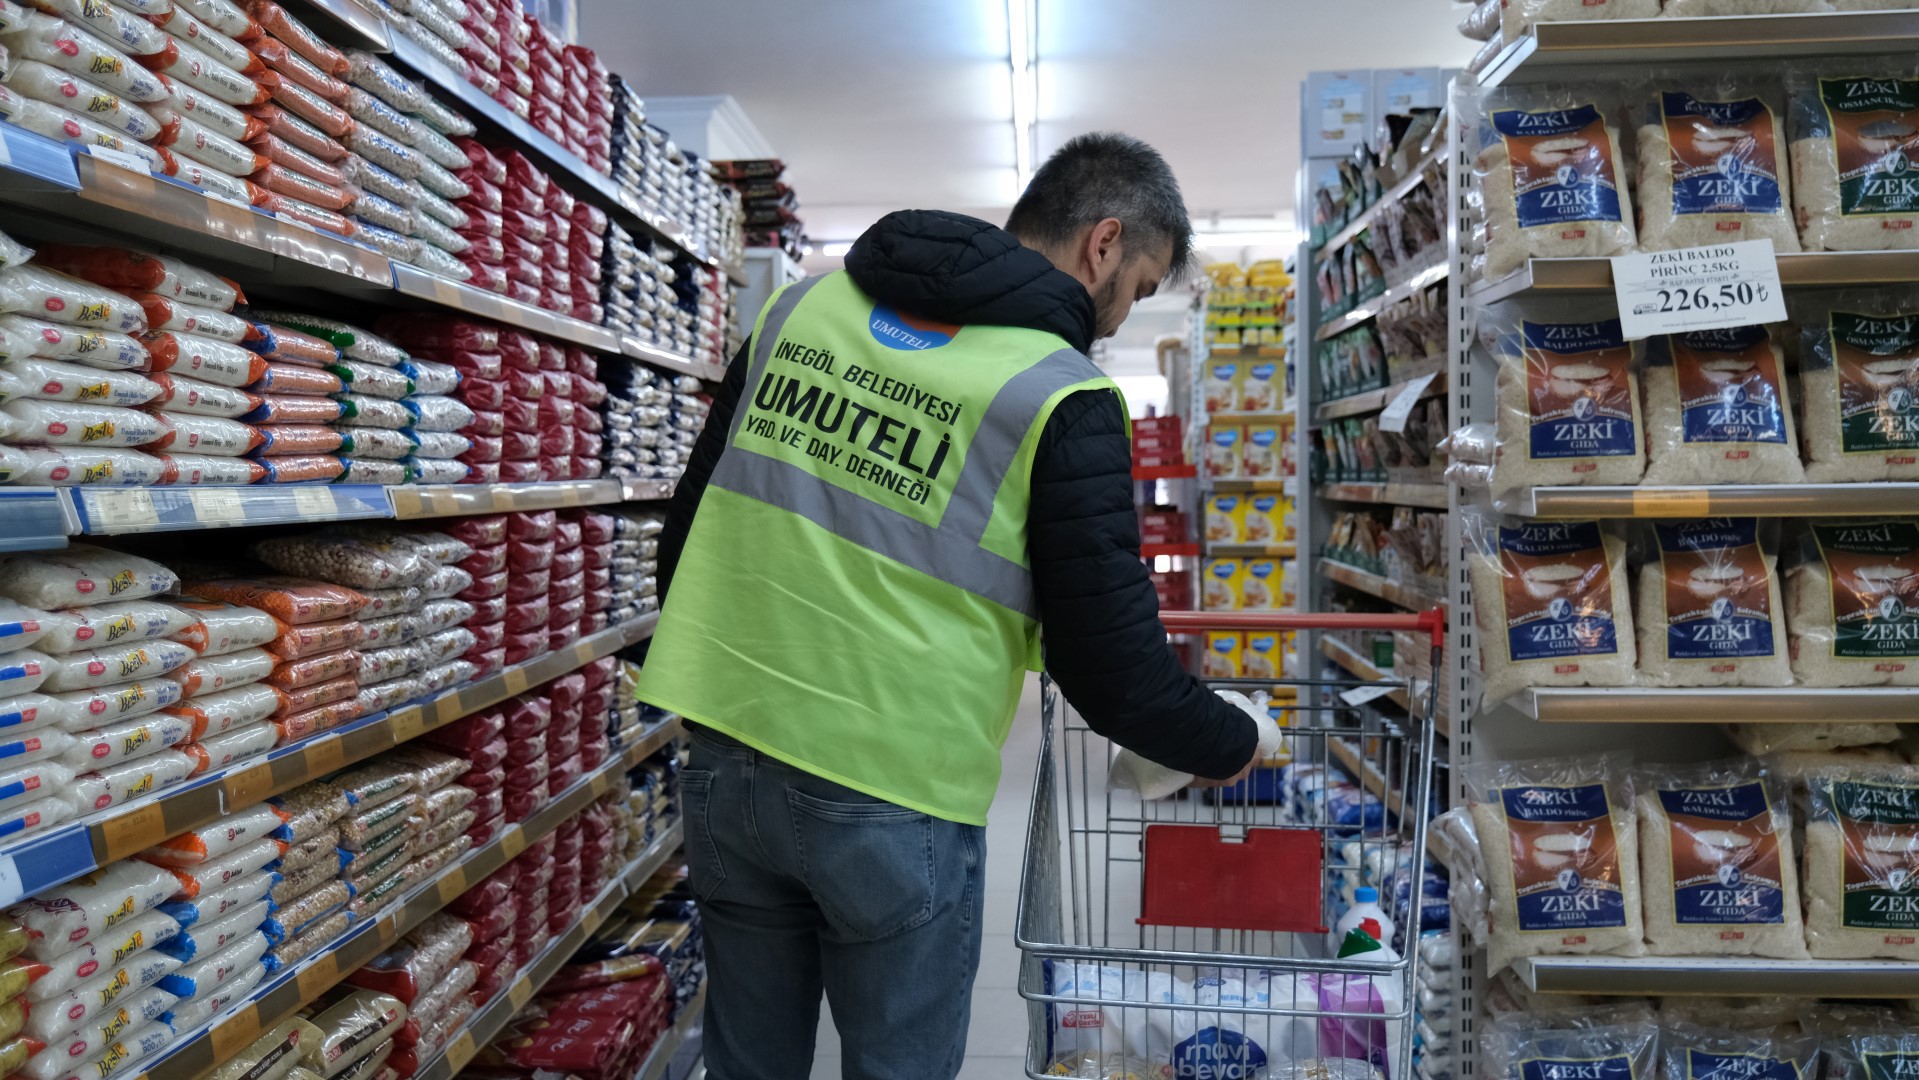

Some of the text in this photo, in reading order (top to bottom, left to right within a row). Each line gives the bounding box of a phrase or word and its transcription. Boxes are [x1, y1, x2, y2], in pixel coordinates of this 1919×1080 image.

[90, 56, 122, 73] Besle
[1846, 79, 1900, 97] ZEKİ
[1517, 110, 1570, 128] ZEKİ
[1698, 177, 1759, 196] ZEKİ
[1867, 178, 1919, 196] ZEK
[1650, 247, 1735, 265] ZEKİ BALDO
[1650, 260, 1739, 278] PİRİNÇ 2,5KG
[872, 318, 932, 350] UMUTELİ
[1544, 323, 1600, 339] ZEKİ
[1543, 340, 1583, 349] BALDO
[774, 338, 963, 426] İNEGÖL BELEDİYESİ
[1531, 408, 1571, 423] Topraktan
[1707, 406, 1765, 425] ZEKİ
[1869, 415, 1919, 433] ZEK
[754, 372, 951, 481] UMUTELİ
[1554, 418, 1614, 441] ZEKİ
[1570, 440, 1599, 448] GIDA
[779, 424, 806, 449] VE
[806, 437, 842, 467] DAY.
[845, 453, 932, 505] DERNEĞİ
[1521, 524, 1570, 542] ZEKİ
[1835, 524, 1892, 542] ZEKİ
[110, 569, 136, 596] Besle
[1508, 608, 1550, 625] Topraktan
[1669, 606, 1770, 623] Topraktan Sofranıza
[1693, 619, 1753, 642] ZEKİ
[1550, 640, 1579, 649] GIDA
[1709, 641, 1739, 649] GIDA
[1877, 640, 1906, 649] GIDA
[121, 649, 148, 676] Besle
[1681, 789, 1736, 807] ZEKİ
[1523, 807, 1562, 818] BALDO
[1682, 805, 1721, 816] BALDO
[1518, 879, 1556, 895] Topraktan
[1675, 872, 1780, 888] Topraktan Sofranıza
[1541, 890, 1601, 913] ZEKİ
[1700, 886, 1761, 907] ZEKİ
[1869, 895, 1919, 912] ZEK
[1557, 911, 1588, 921] GIDA
[1716, 906, 1746, 916] GIDA
[1886, 912, 1915, 921] GIDA
[1185, 1036, 1250, 1061] mavi
[1545, 1062, 1602, 1079] ZEKİ
